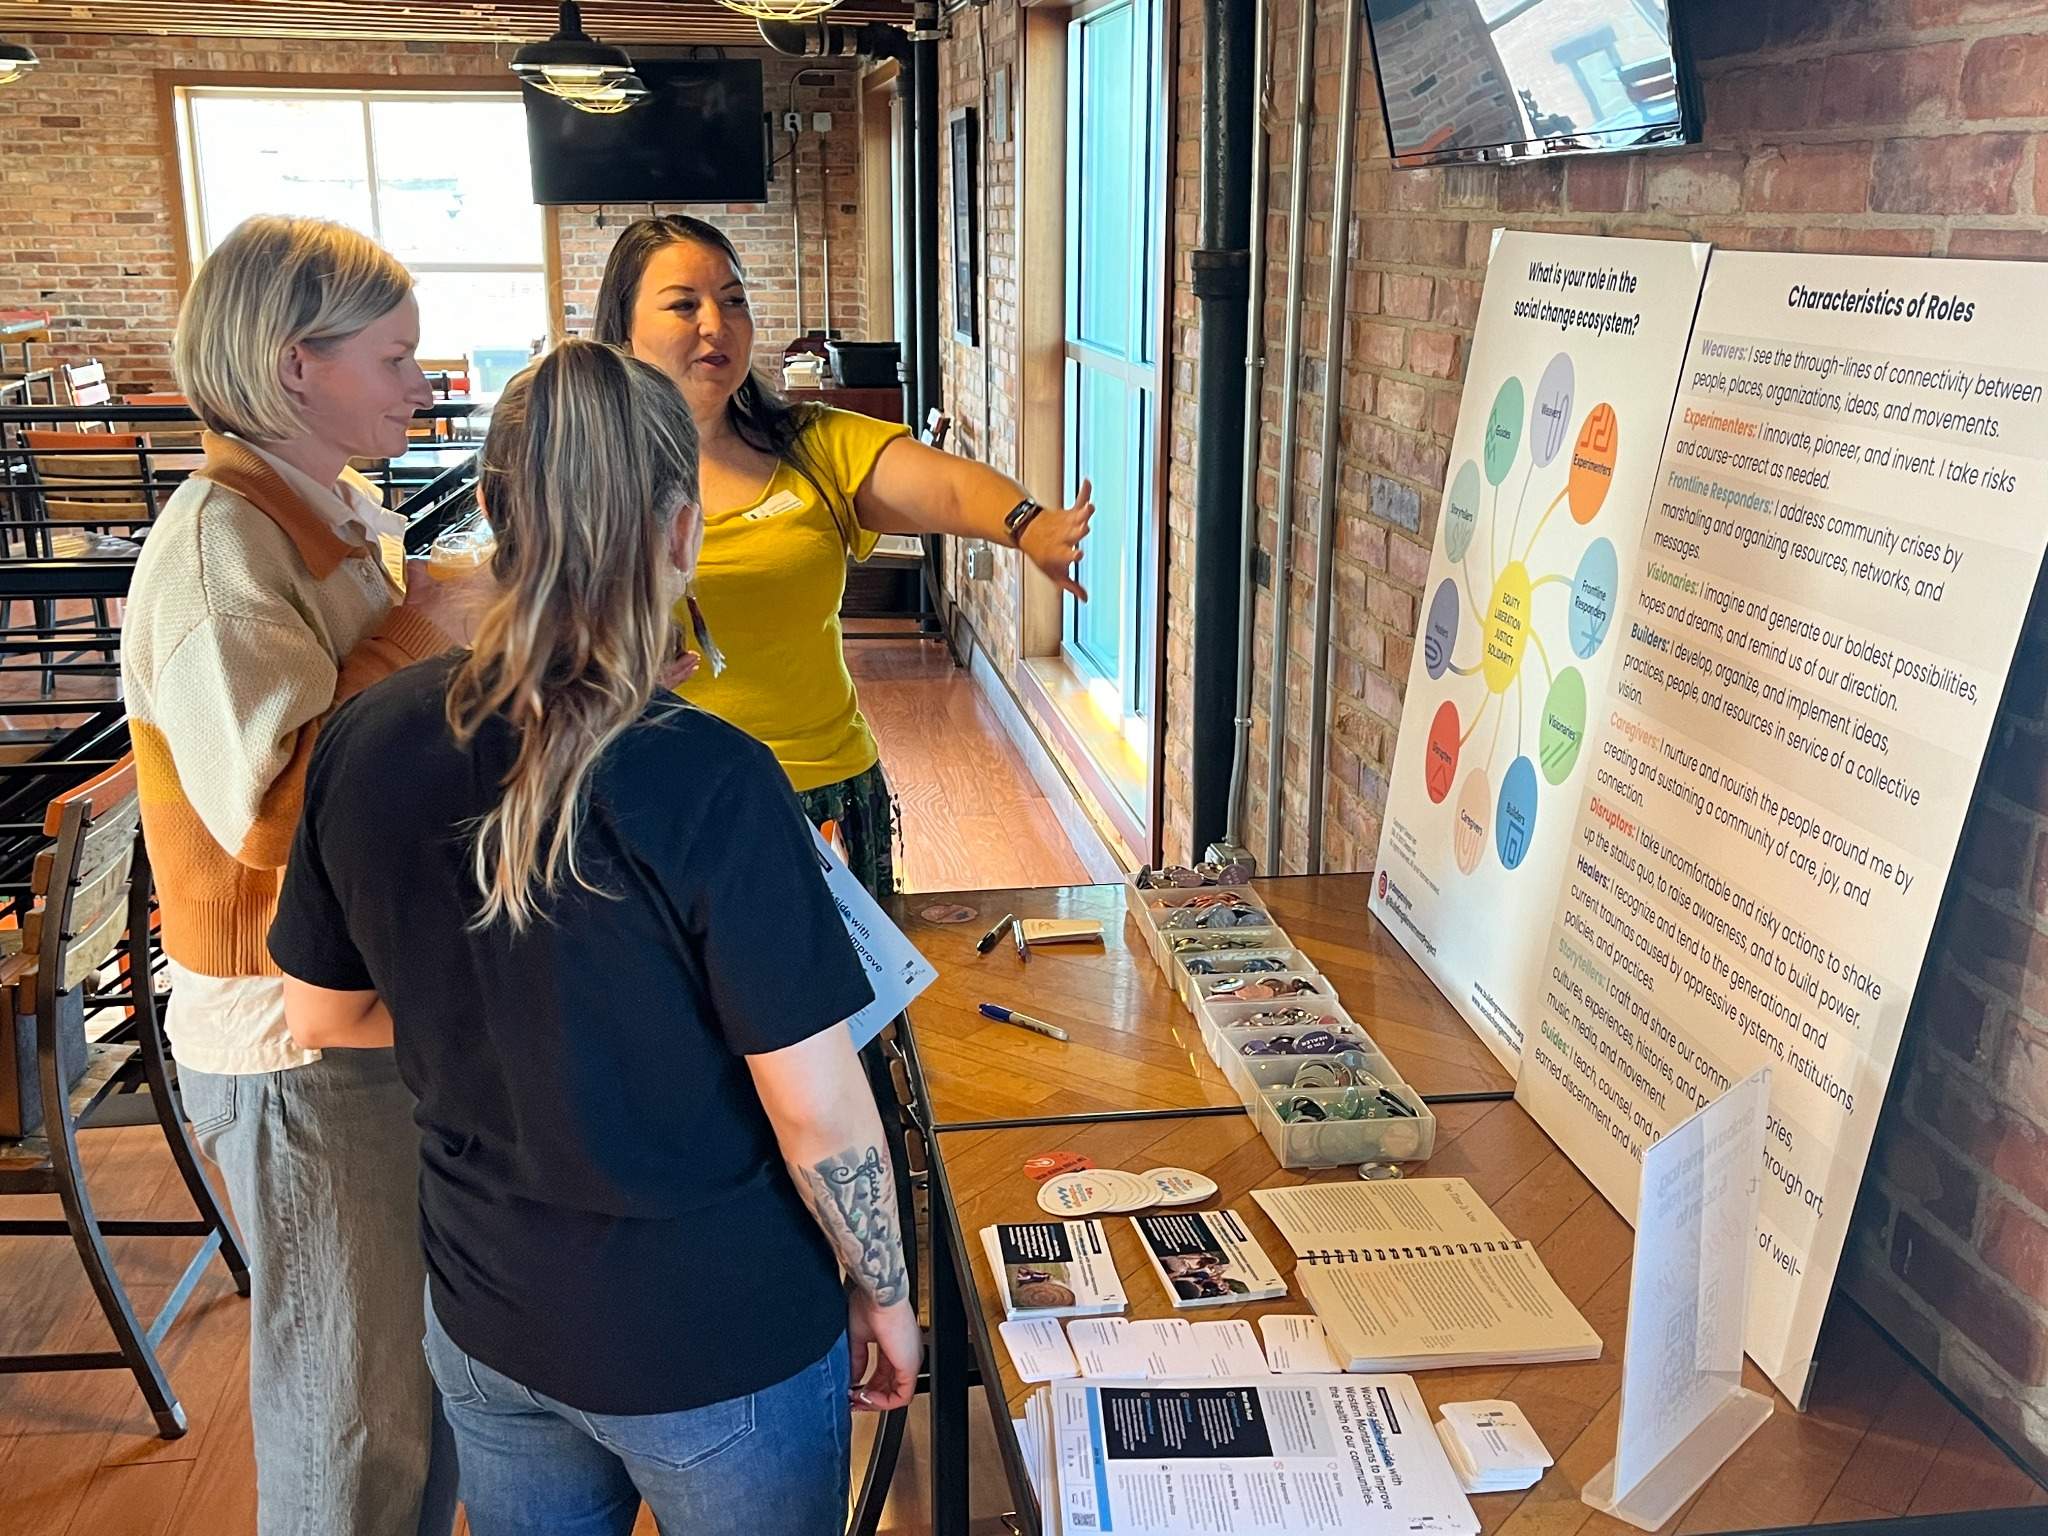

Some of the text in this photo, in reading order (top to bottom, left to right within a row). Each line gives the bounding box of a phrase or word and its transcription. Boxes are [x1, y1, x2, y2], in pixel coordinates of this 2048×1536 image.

[1528, 261, 1637, 293] What is your role in the
[1513, 296, 1640, 338] social change ecosystem?
[1788, 285, 1975, 322] Characteristics of Roles
[1701, 336, 1748, 360] Weavers:
[1753, 349, 1772, 364] see
[1773, 349, 1791, 367] the
[1793, 351, 1872, 379] through-lines
[1874, 361, 1889, 380] of
[1889, 368, 1973, 399] connectivity
[1974, 374, 2042, 402] between
[1691, 372, 1998, 437] people, places, organizations, ideas, and movements.
[1573, 453, 1612, 478] Experimenters
[1676, 440, 1830, 489] and course-correct as needed.
[1683, 407, 1757, 438] Experimenters:
[1762, 422, 1810, 453] innovate,
[1812, 434, 1860, 462] pioneer,
[1864, 447, 1892, 466] and
[1892, 448, 1935, 476] invent.
[1946, 461, 1978, 484] take
[1981, 466, 2016, 492] risks
[1667, 470, 1713, 496] Frontline
[1707, 480, 1773, 519] Responders:
[1780, 503, 1825, 529] address
[1827, 517, 1899, 555] community
[1901, 535, 1940, 561] crises
[1943, 544, 1963, 572] by
[1653, 532, 1699, 560] messages.
[1502, 592, 1520, 611] EQUITY
[1575, 595, 1607, 621] Responders
[1582, 579, 1607, 601] Frontline
[1494, 608, 1521, 632] LIBERATION
[1494, 628, 1514, 647] JUSTICE
[1647, 561, 1699, 595] Visionaries:
[1704, 582, 1744, 613] imagine
[1746, 602, 1769, 621] and
[1767, 611, 1820, 641] generate
[1822, 631, 1843, 649] our
[1844, 634, 1893, 669] boldest
[1892, 658, 1977, 705] possibilities,
[1487, 642, 1514, 667] SOLIDARITY
[1618, 680, 1641, 705] vision.
[1631, 622, 1670, 653] Builders:
[1674, 640, 1712, 677] develop,
[1715, 663, 1759, 697] organize,
[1762, 684, 1786, 704] and
[1786, 689, 1851, 735] implement
[1852, 718, 1888, 755] ideas,
[1548, 713, 1577, 742] Visionaries
[1597, 769, 1643, 807] connection.
[1610, 711, 1659, 750] Caregivers:
[1663, 743, 1698, 771] nurture
[1699, 763, 1720, 784] and
[1719, 774, 1758, 806] nourish
[1760, 793, 1778, 816] the
[1778, 807, 1820, 839] people
[1822, 830, 1869, 865] around
[1869, 856, 1892, 878] me
[1894, 864, 1913, 895] by
[1460, 808, 1484, 838] Caregivers
[1507, 801, 1526, 826] Builders
[1590, 797, 1635, 838] Disruptors:
[1640, 829, 1659, 854] take
[1660, 846, 1730, 901] uncomfortable
[1732, 893, 1755, 917] and
[1754, 906, 1780, 939] risky
[1781, 926, 1825, 964] actions
[1827, 952, 1839, 973] to
[1842, 964, 1881, 1000] shake
[850, 915, 871, 941] with
[849, 933, 884, 974] improve
[1564, 911, 1654, 992] policies, and practices.
[1577, 854, 1610, 890] Healers:
[1614, 885, 1655, 923] recognize
[1657, 916, 1676, 938] and
[1676, 928, 1700, 956] tend
[1700, 944, 1710, 964] to
[1712, 953, 1729, 977] the
[1729, 970, 1801, 1030] generational
[1802, 1022, 1828, 1049] and
[1571, 878, 1853, 1114] current traumas caused by oppressive systems, institutions,
[1329, 1386, 1373, 1506] the health of our communities.
[1345, 1386, 1393, 1511] Western Montanans to improve
[1360, 1386, 1378, 1418] Working
[1388, 1467, 1402, 1487] with
